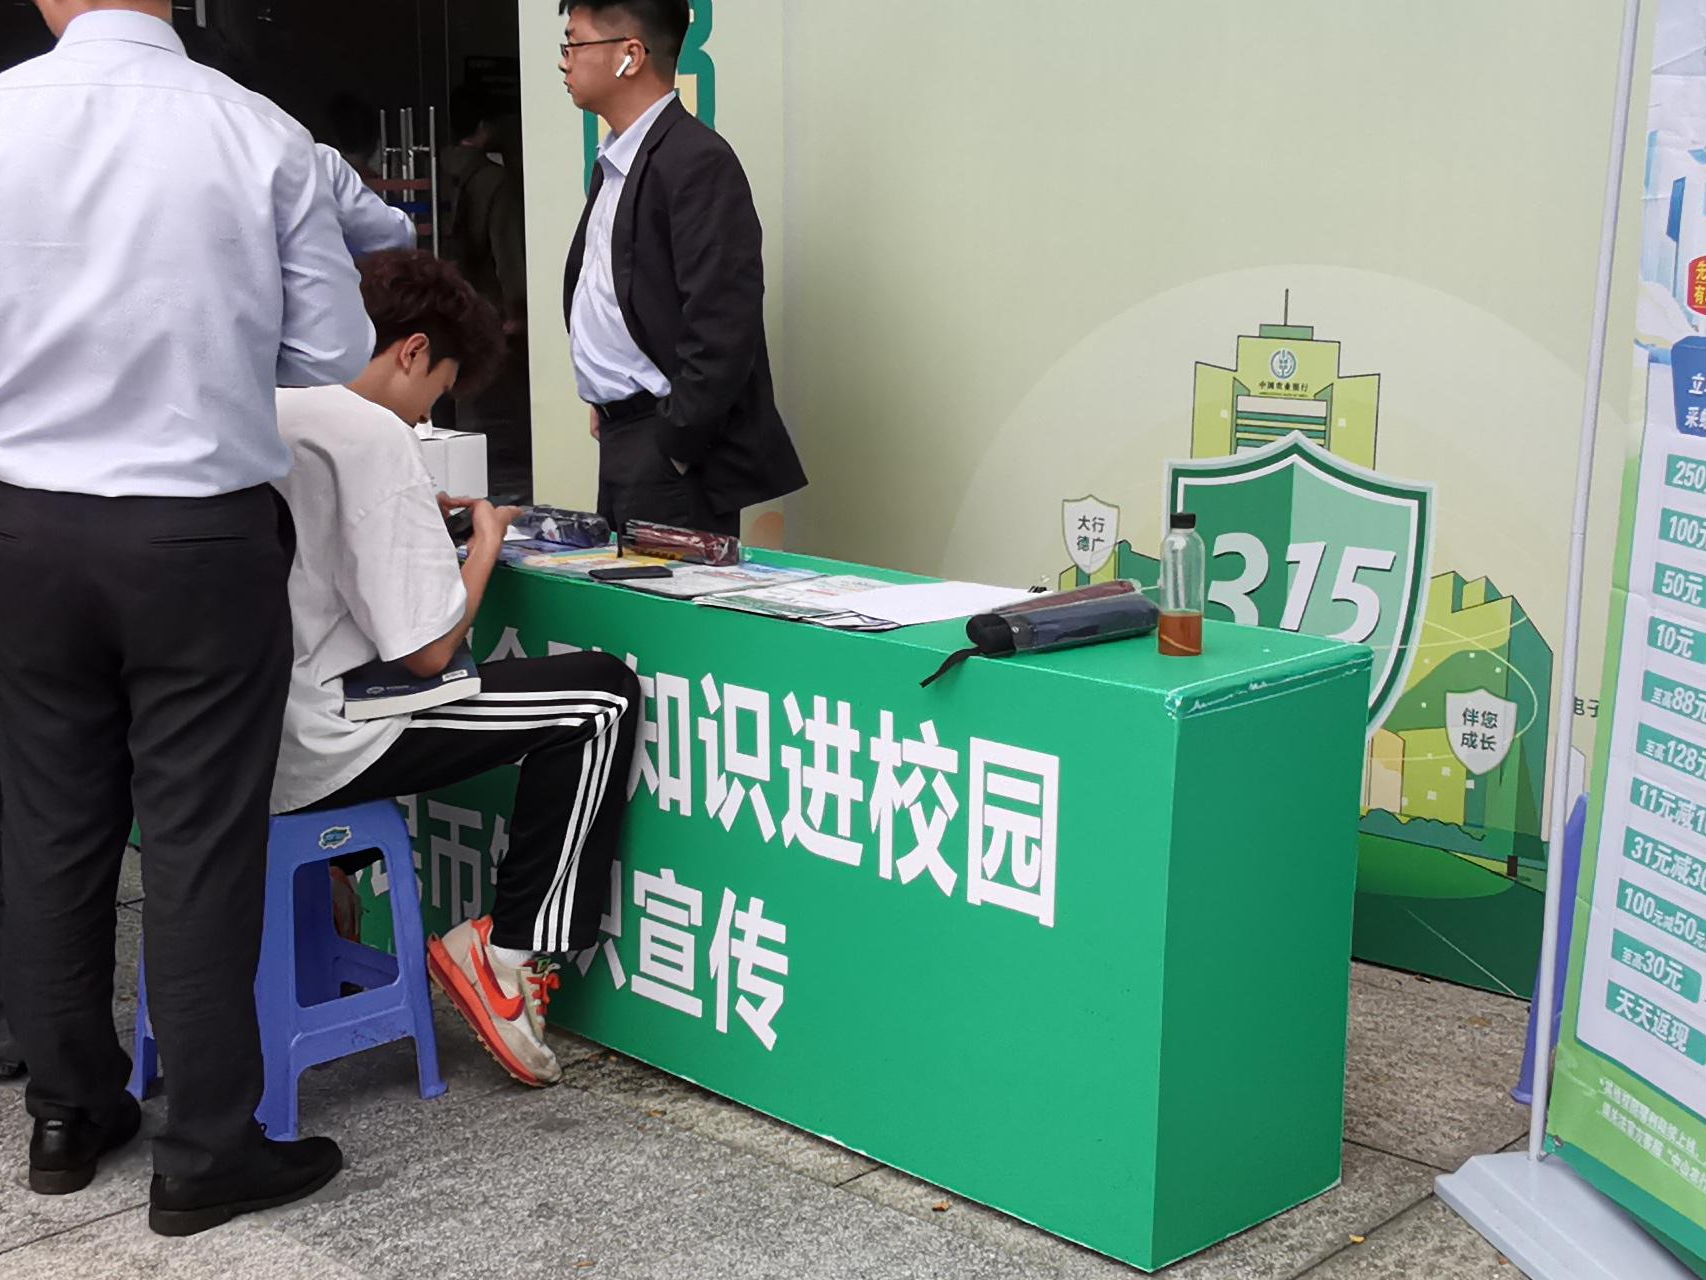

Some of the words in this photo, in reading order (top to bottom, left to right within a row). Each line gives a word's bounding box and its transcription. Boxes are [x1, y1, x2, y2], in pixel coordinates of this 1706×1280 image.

[1077, 515, 1105, 533] 大行
[1076, 534, 1105, 552] 德广
[1207, 531, 1397, 645] 315
[1660, 569, 1704, 606] 50元
[1655, 622, 1695, 659] 10元
[1461, 706, 1498, 729] 伴您
[1460, 731, 1497, 752] 成长
[1613, 988, 1691, 1054] 天天返现
